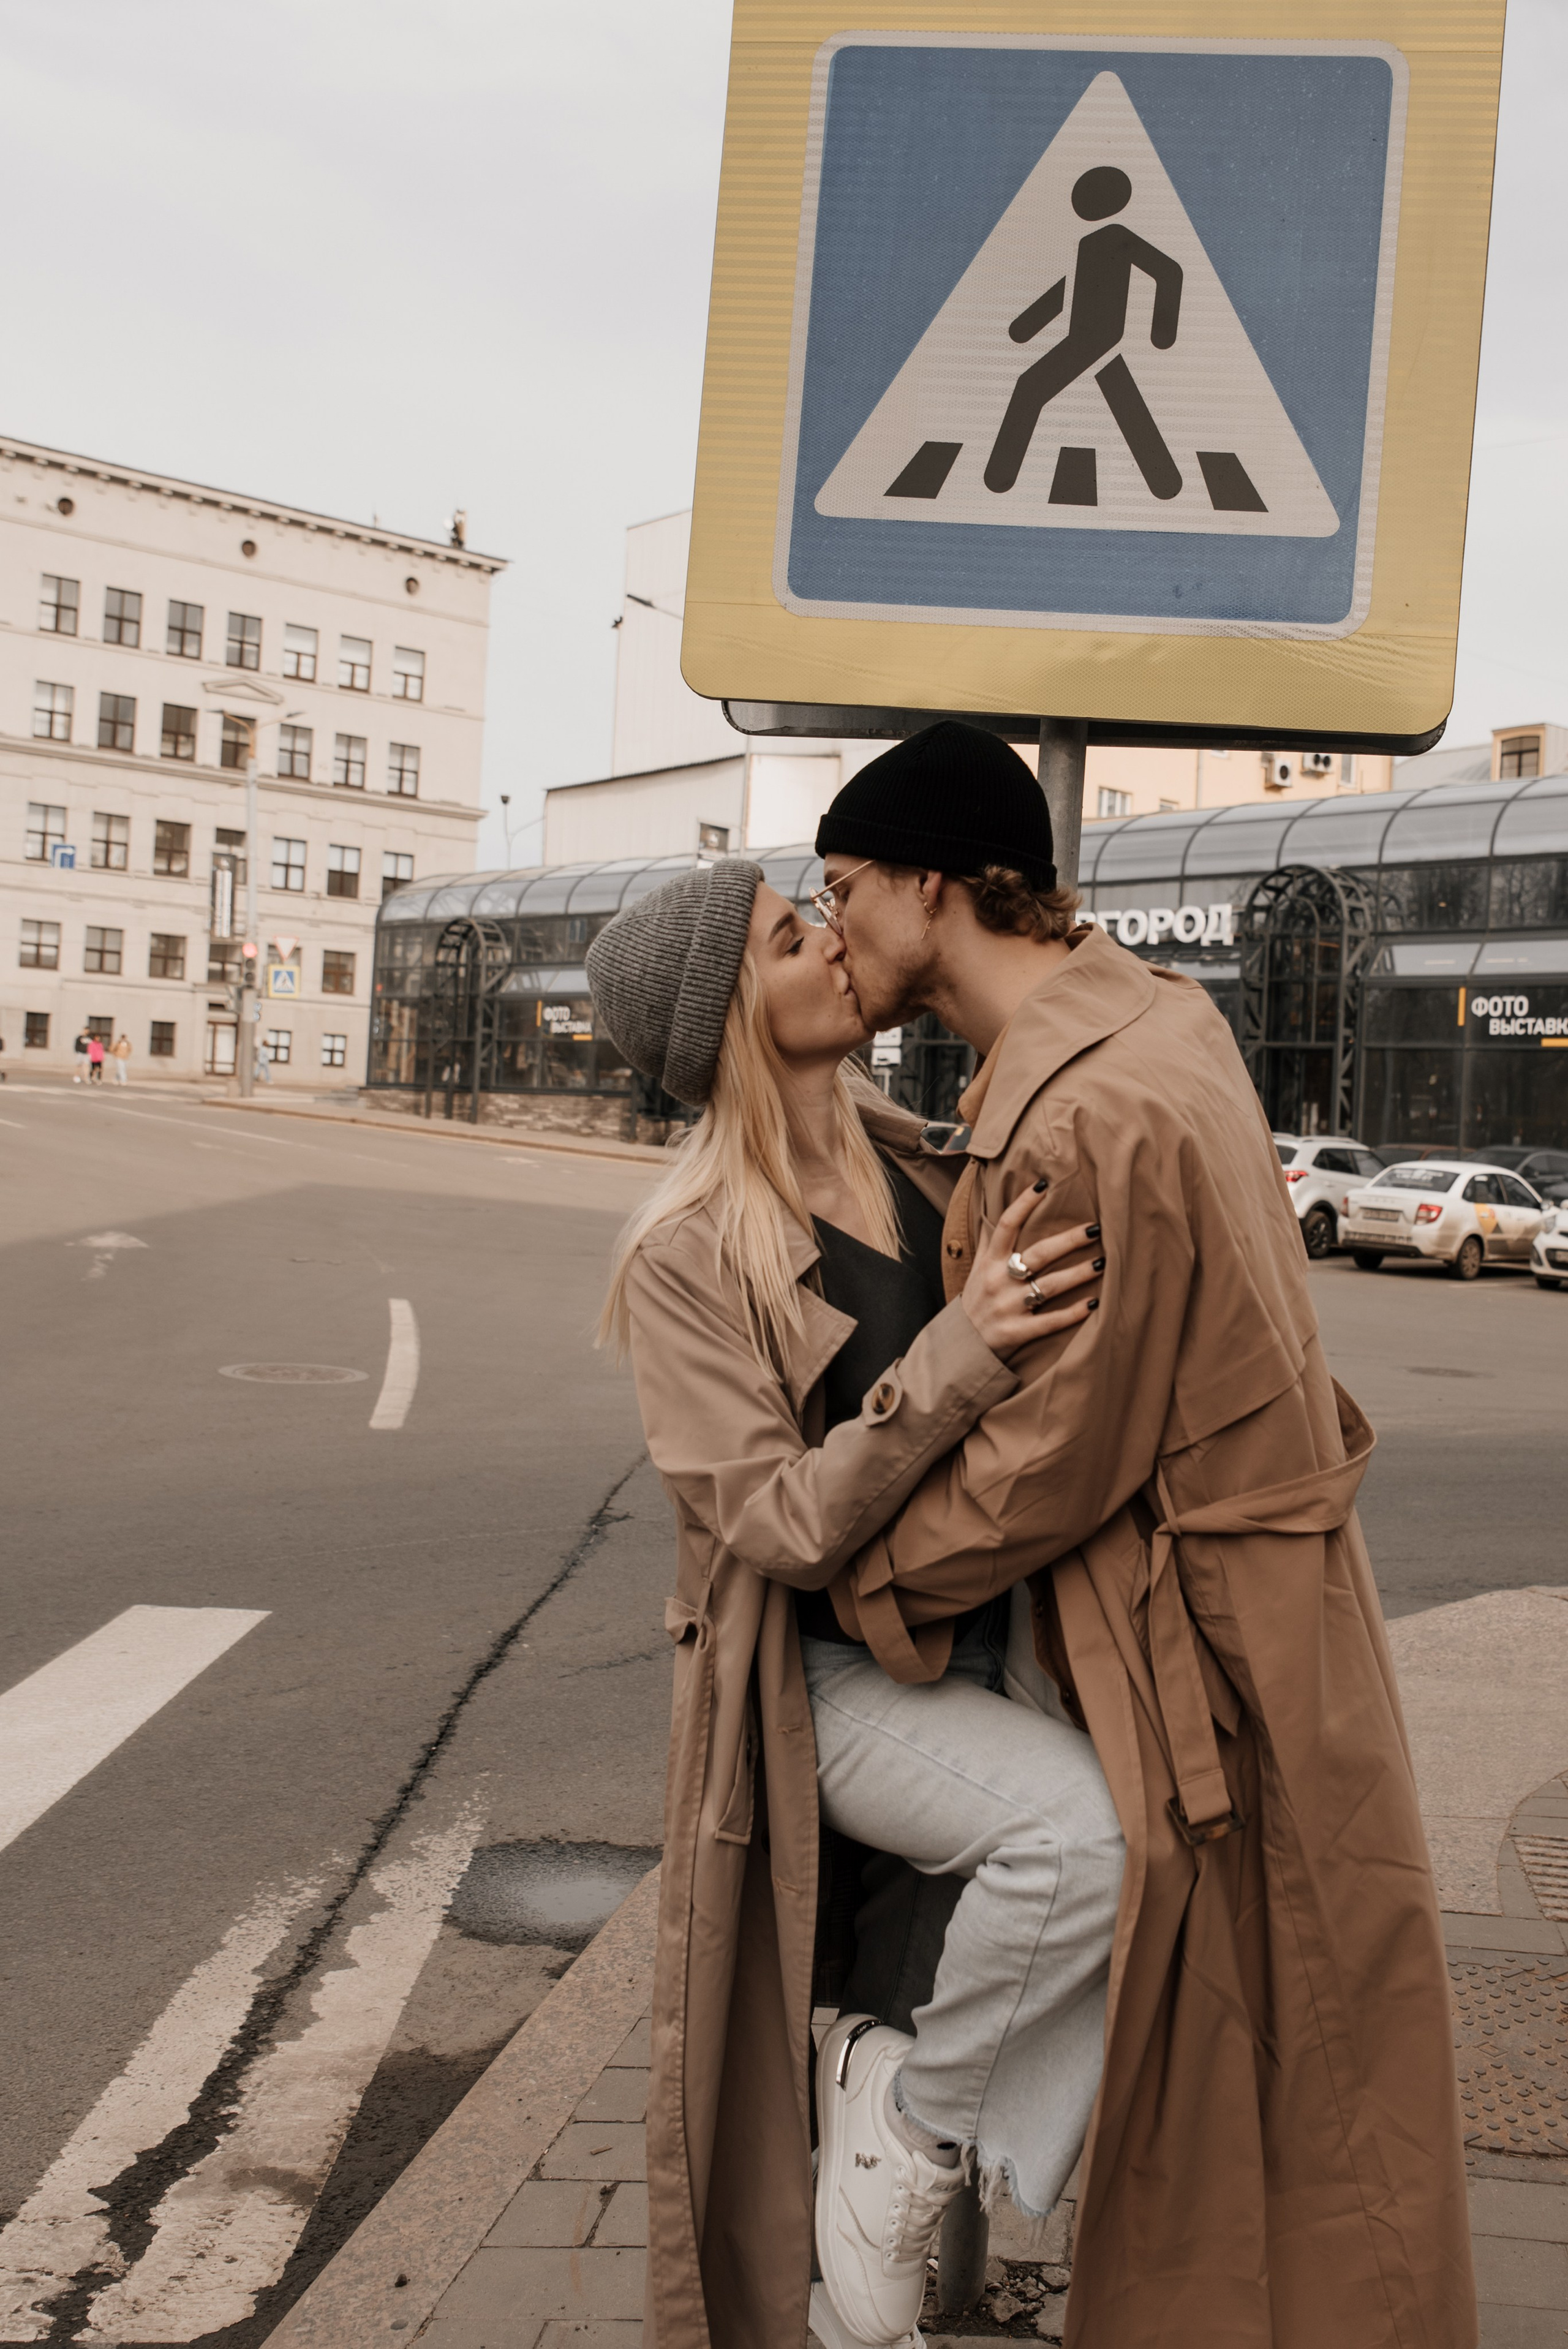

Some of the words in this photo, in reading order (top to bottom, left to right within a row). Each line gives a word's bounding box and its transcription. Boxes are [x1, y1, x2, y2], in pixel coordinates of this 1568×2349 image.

[543, 1006, 570, 1021] ФОТО
[1471, 995, 1529, 1017] ФОТО
[1489, 1017, 1568, 1035] ВЫСТАВК
